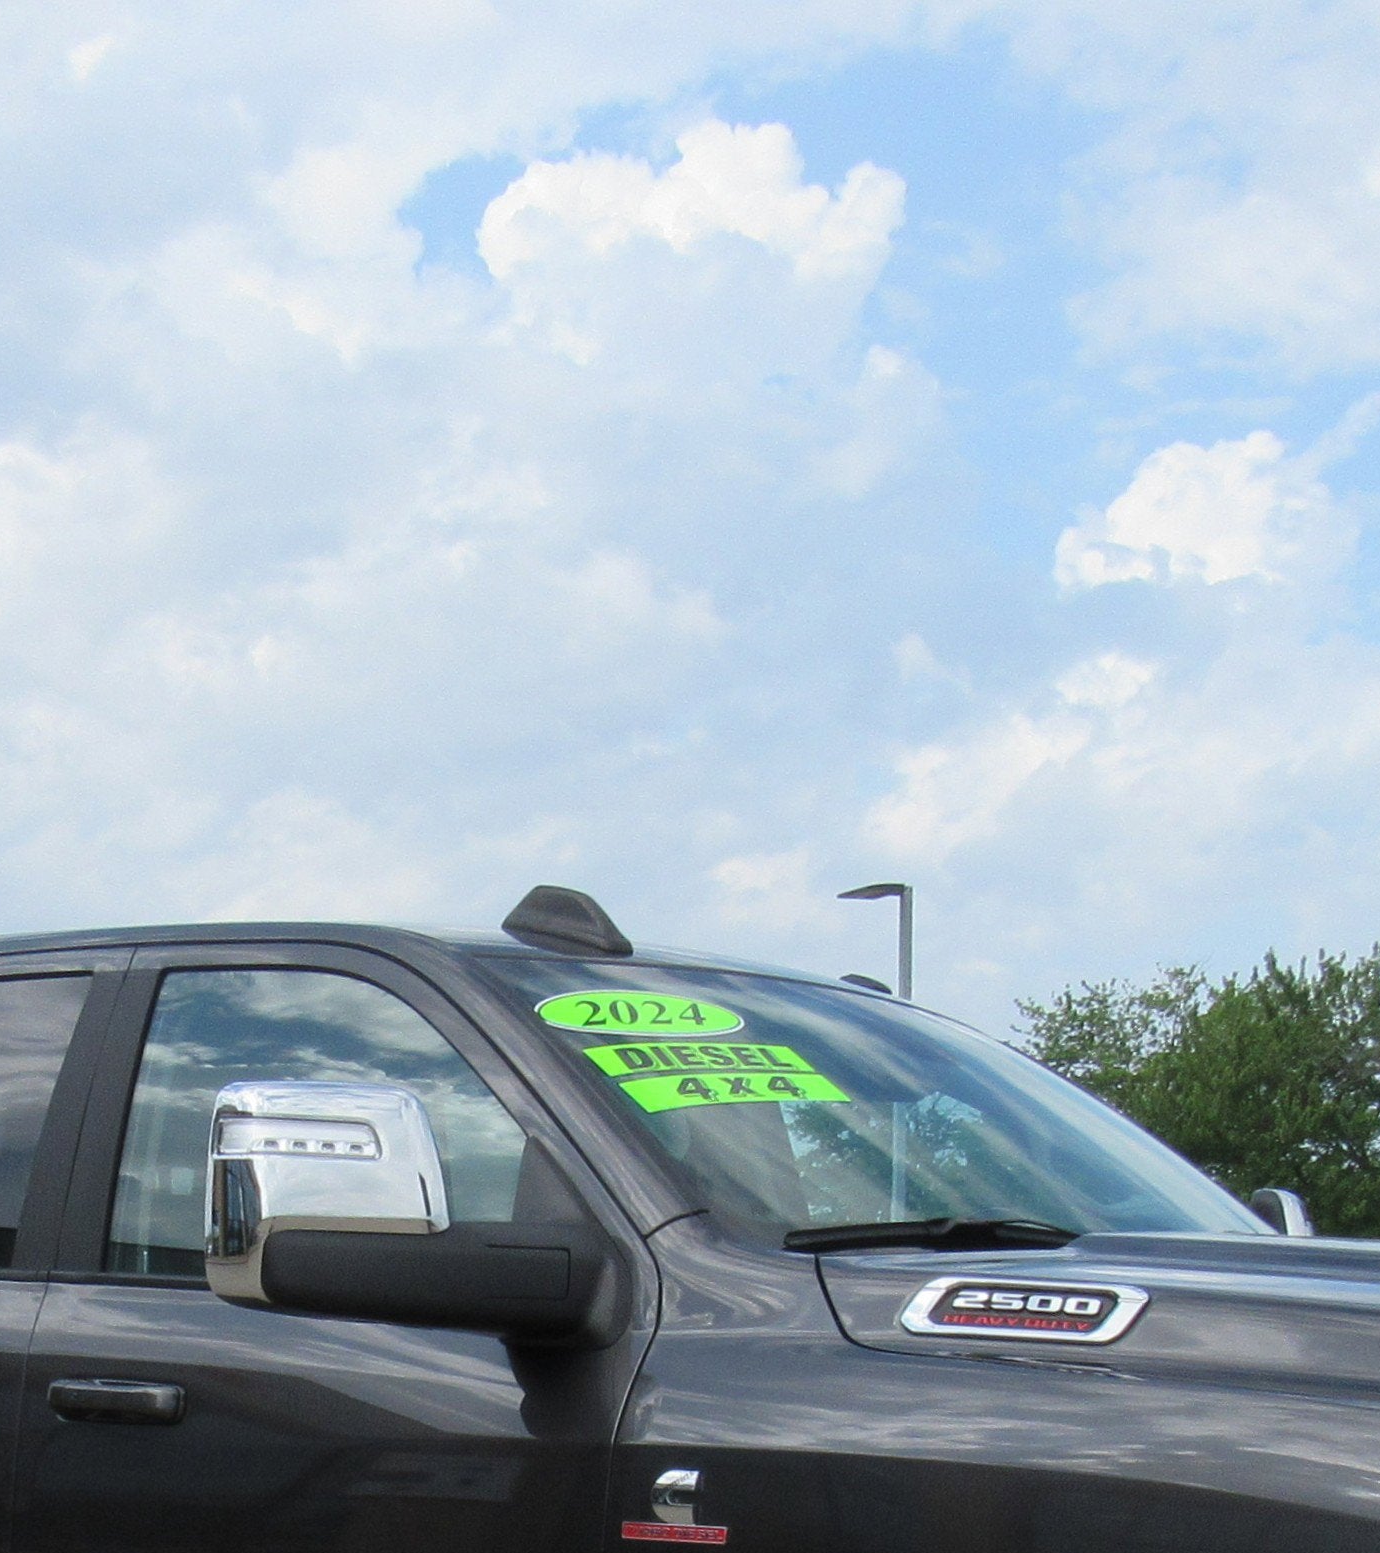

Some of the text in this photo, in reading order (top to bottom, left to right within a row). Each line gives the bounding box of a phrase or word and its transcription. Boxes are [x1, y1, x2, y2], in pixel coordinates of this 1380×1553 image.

[575, 999, 707, 1027] 2024
[613, 1045, 797, 1071] DIESEL
[951, 1290, 1102, 1316] 2500
